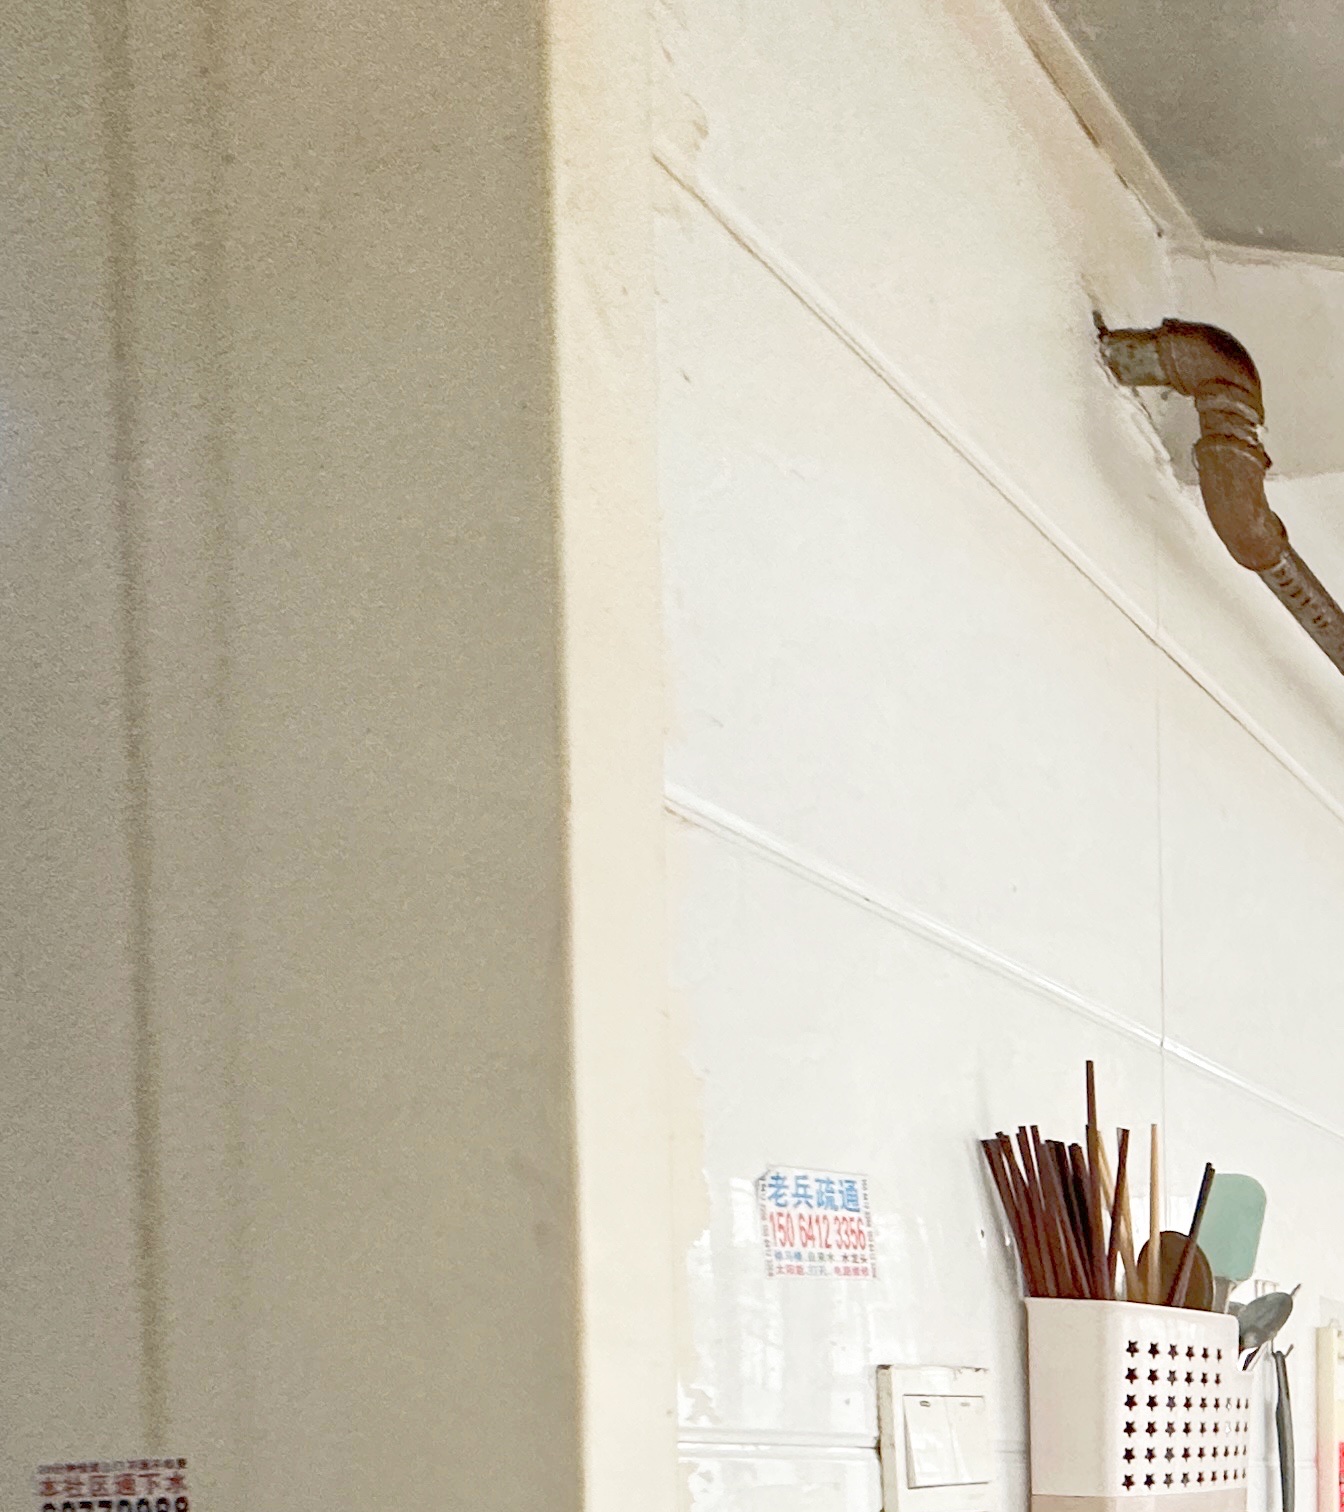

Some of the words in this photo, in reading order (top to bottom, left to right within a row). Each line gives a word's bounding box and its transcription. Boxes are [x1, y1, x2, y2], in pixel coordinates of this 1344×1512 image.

[767, 1172, 861, 1212] 老兵疏通
[769, 1211, 796, 1248] 150
[798, 1212, 832, 1250] 6412
[834, 1214, 868, 1251] 3356
